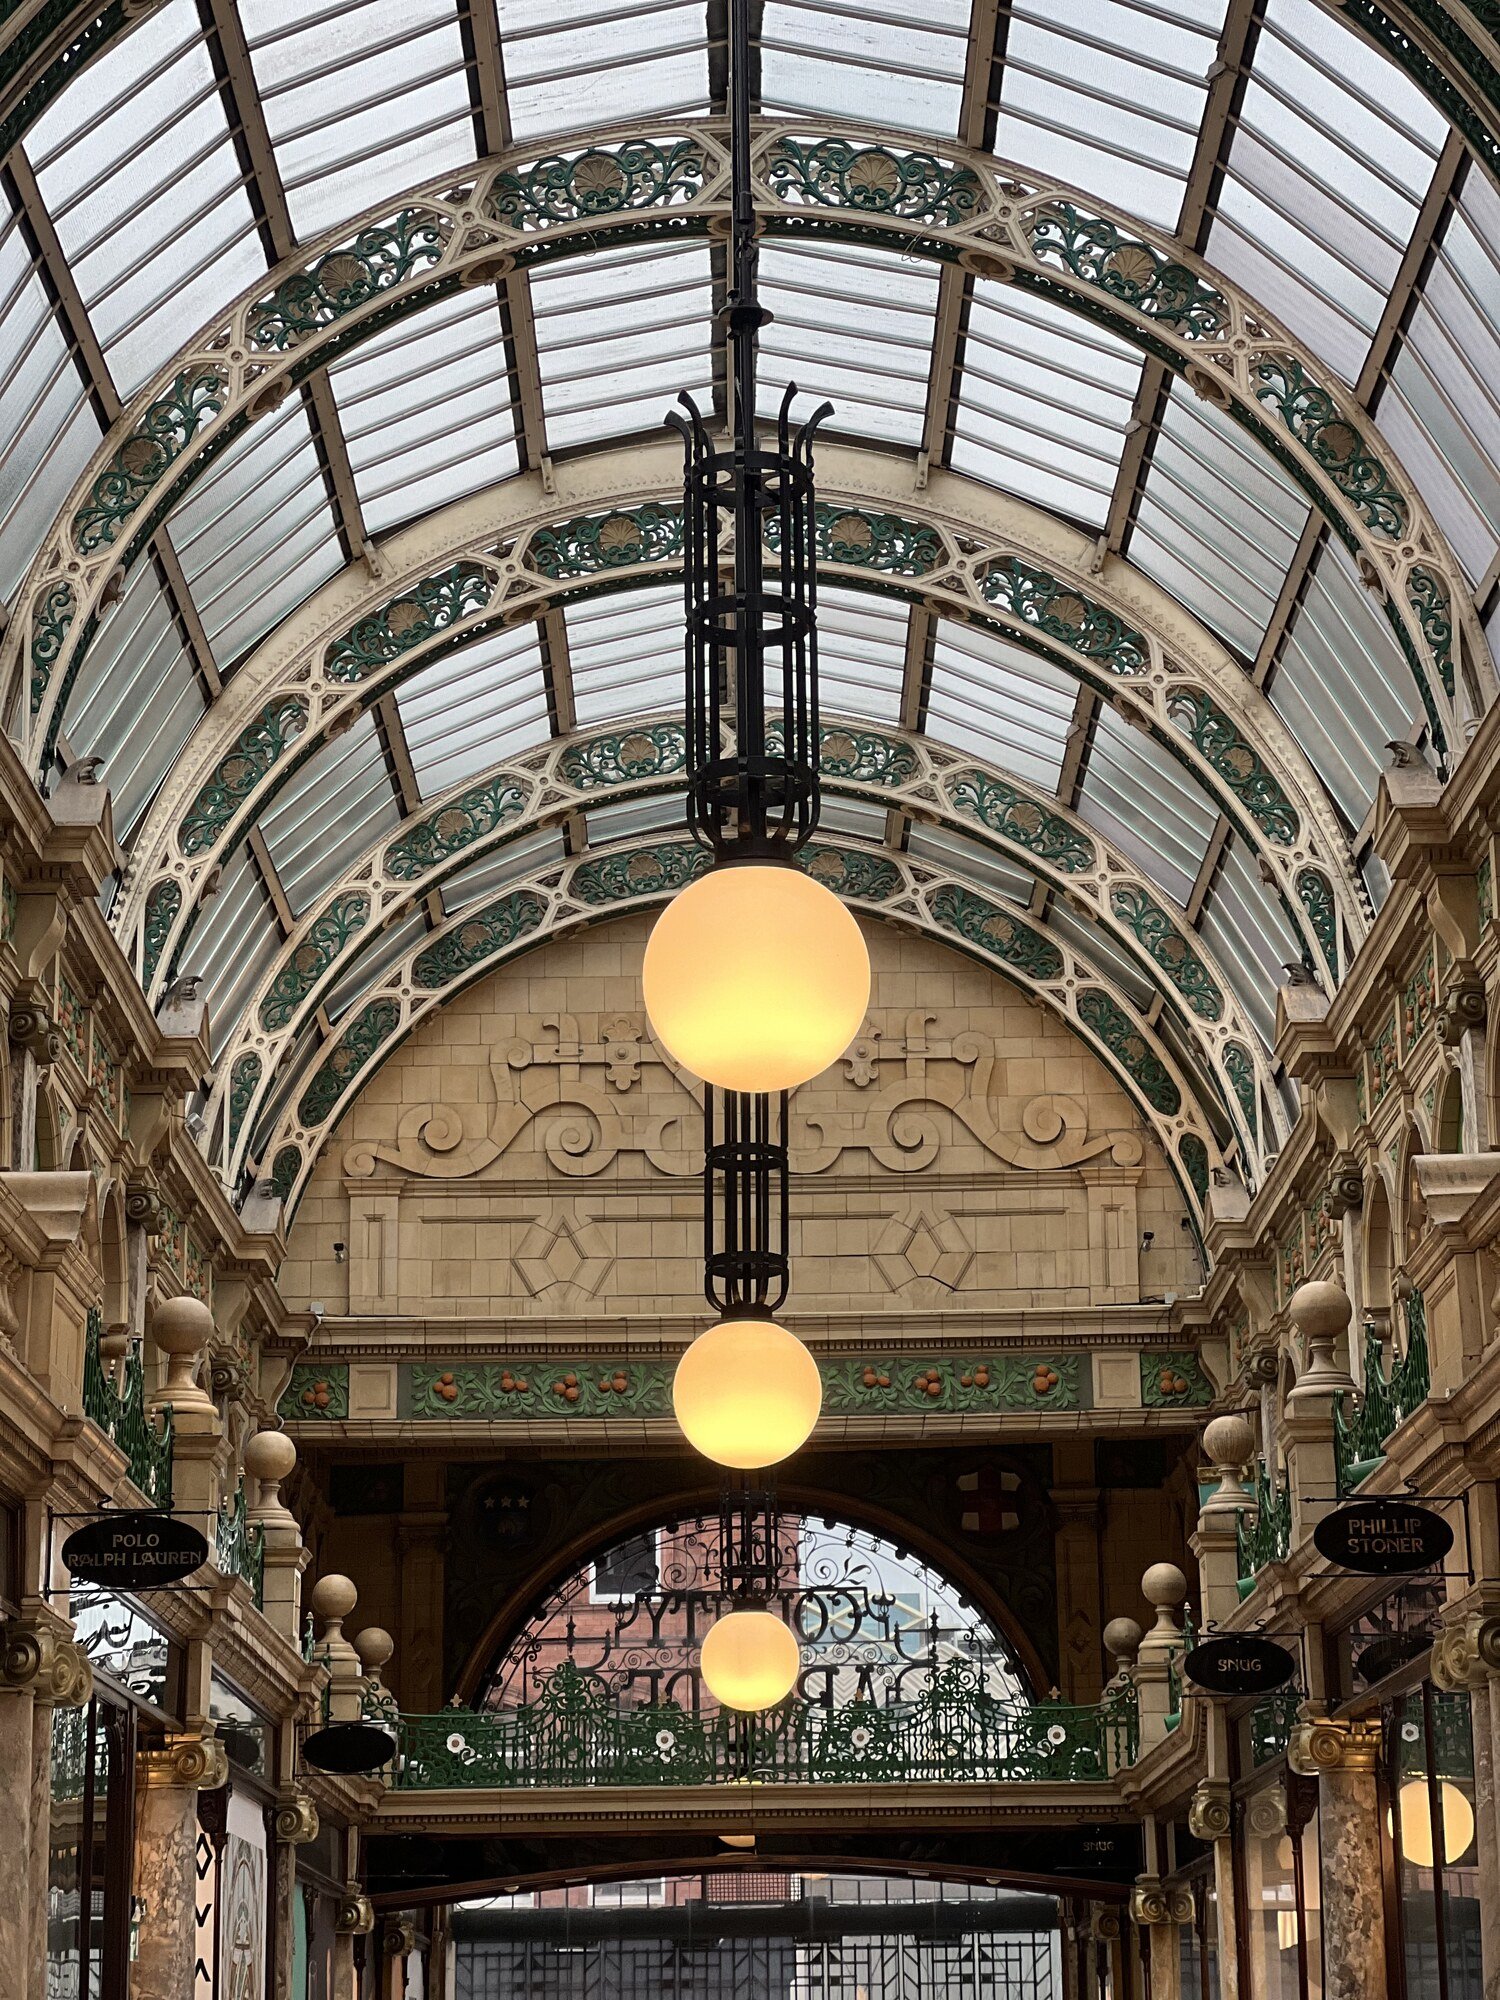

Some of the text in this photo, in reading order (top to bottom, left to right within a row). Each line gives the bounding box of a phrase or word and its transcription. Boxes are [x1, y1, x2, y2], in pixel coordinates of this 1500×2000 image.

[1348, 1518, 1422, 1535] PHILLIP
[112, 1533, 160, 1548] POLO
[1347, 1537, 1425, 1554] STONER
[67, 1551, 202, 1567] RALPH LAUREN
[1217, 1658, 1262, 1672] SNUG
[1082, 1841, 1115, 1851] SNUG
